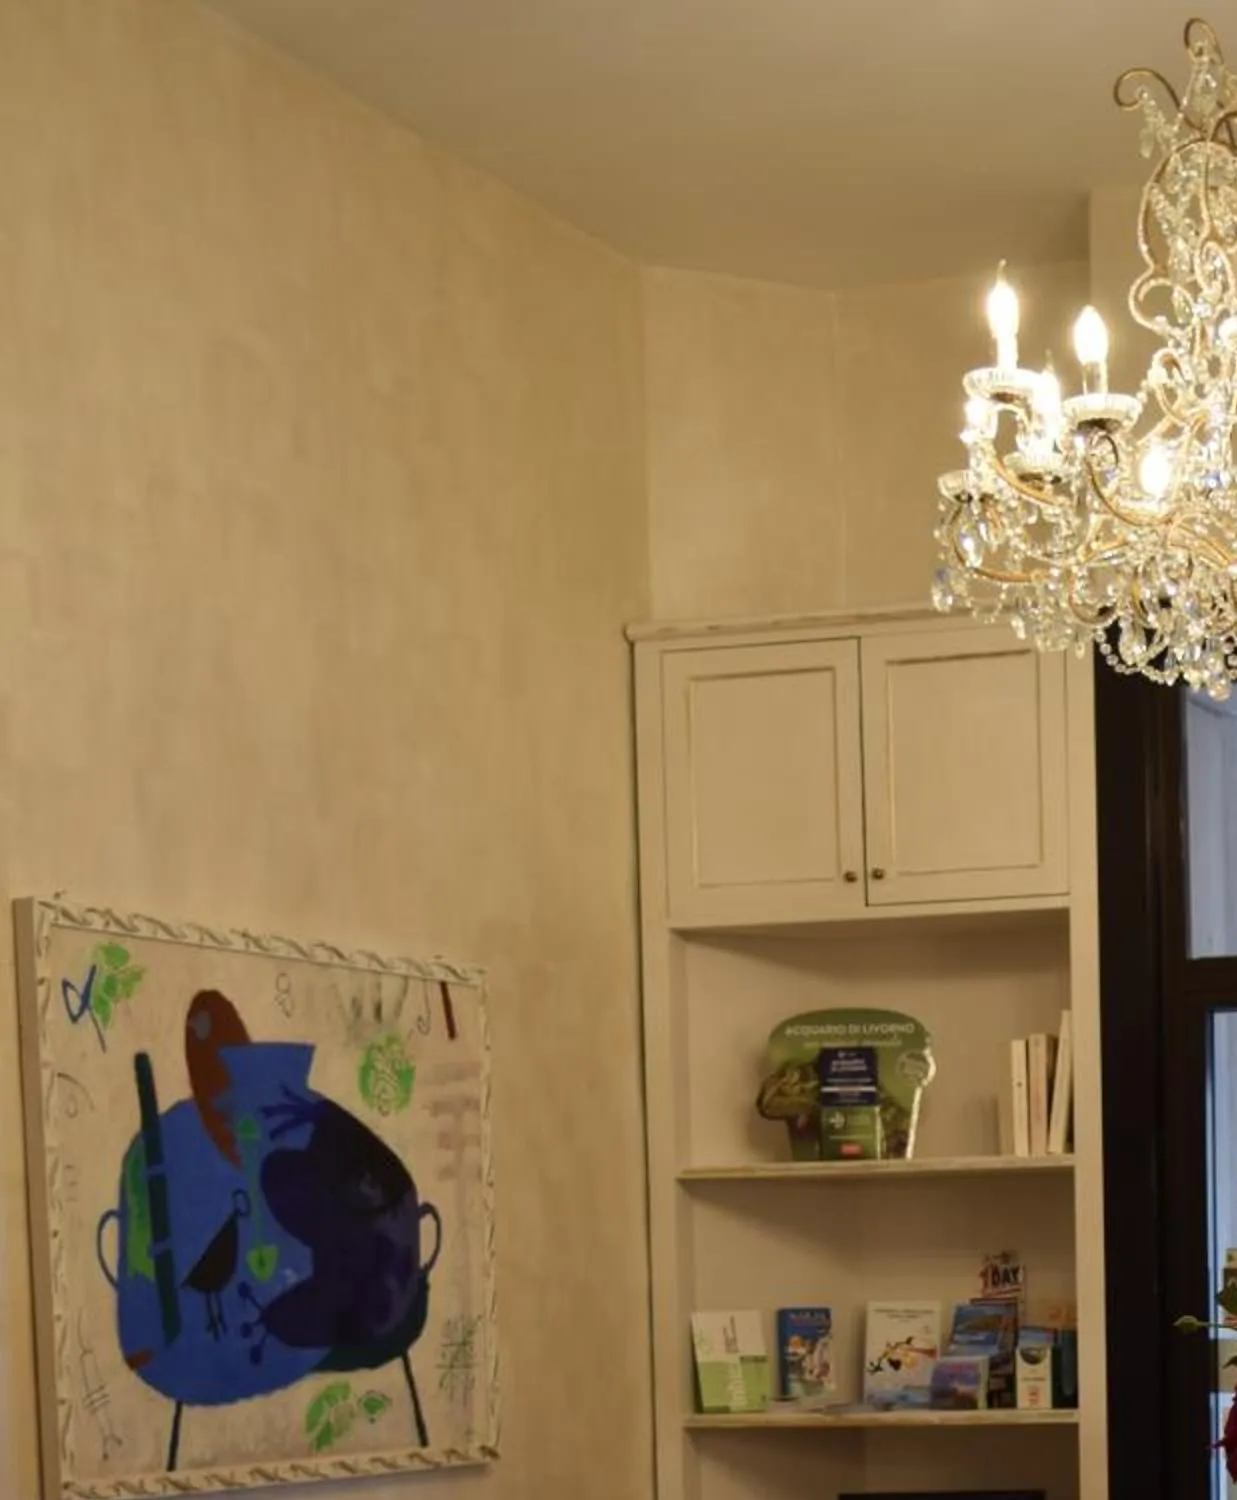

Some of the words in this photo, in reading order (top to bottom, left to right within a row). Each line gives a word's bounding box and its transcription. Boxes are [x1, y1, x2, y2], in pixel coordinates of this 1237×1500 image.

[785, 1024, 845, 1037] ACQUARIO
[848, 1024, 861, 1035] DI
[863, 1023, 915, 1035] LIVORNO
